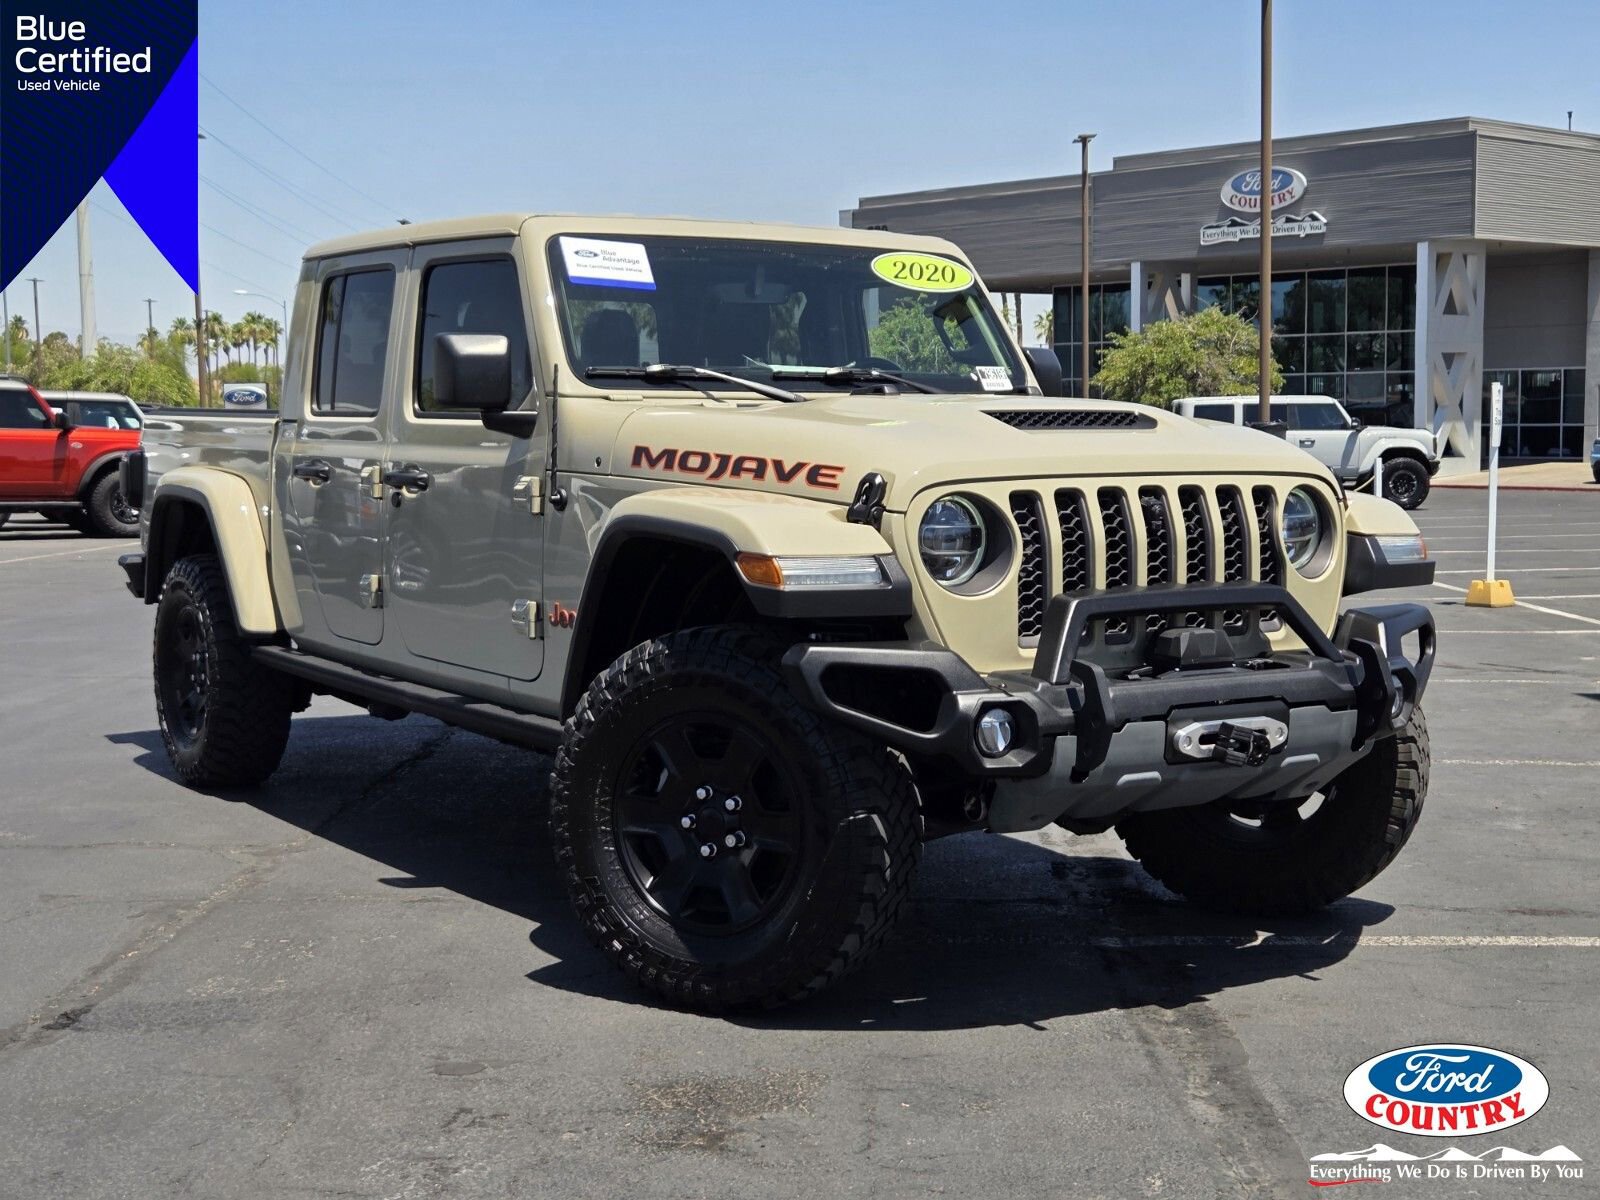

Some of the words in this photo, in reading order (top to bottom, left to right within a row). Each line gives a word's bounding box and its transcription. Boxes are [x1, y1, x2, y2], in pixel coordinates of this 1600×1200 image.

[1242, 172, 1283, 191] Fod
[1230, 187, 1295, 208] COUTRY
[1202, 230, 1238, 239] Everything
[1240, 227, 1251, 236] We
[1272, 225, 1296, 233] Driven
[1298, 224, 1306, 233] By
[1309, 223, 1322, 231] You
[893, 261, 956, 283] 2020
[232, 391, 257, 402] Ford
[631, 445, 845, 490] MOJAVE
[549, 602, 577, 630] Jee
